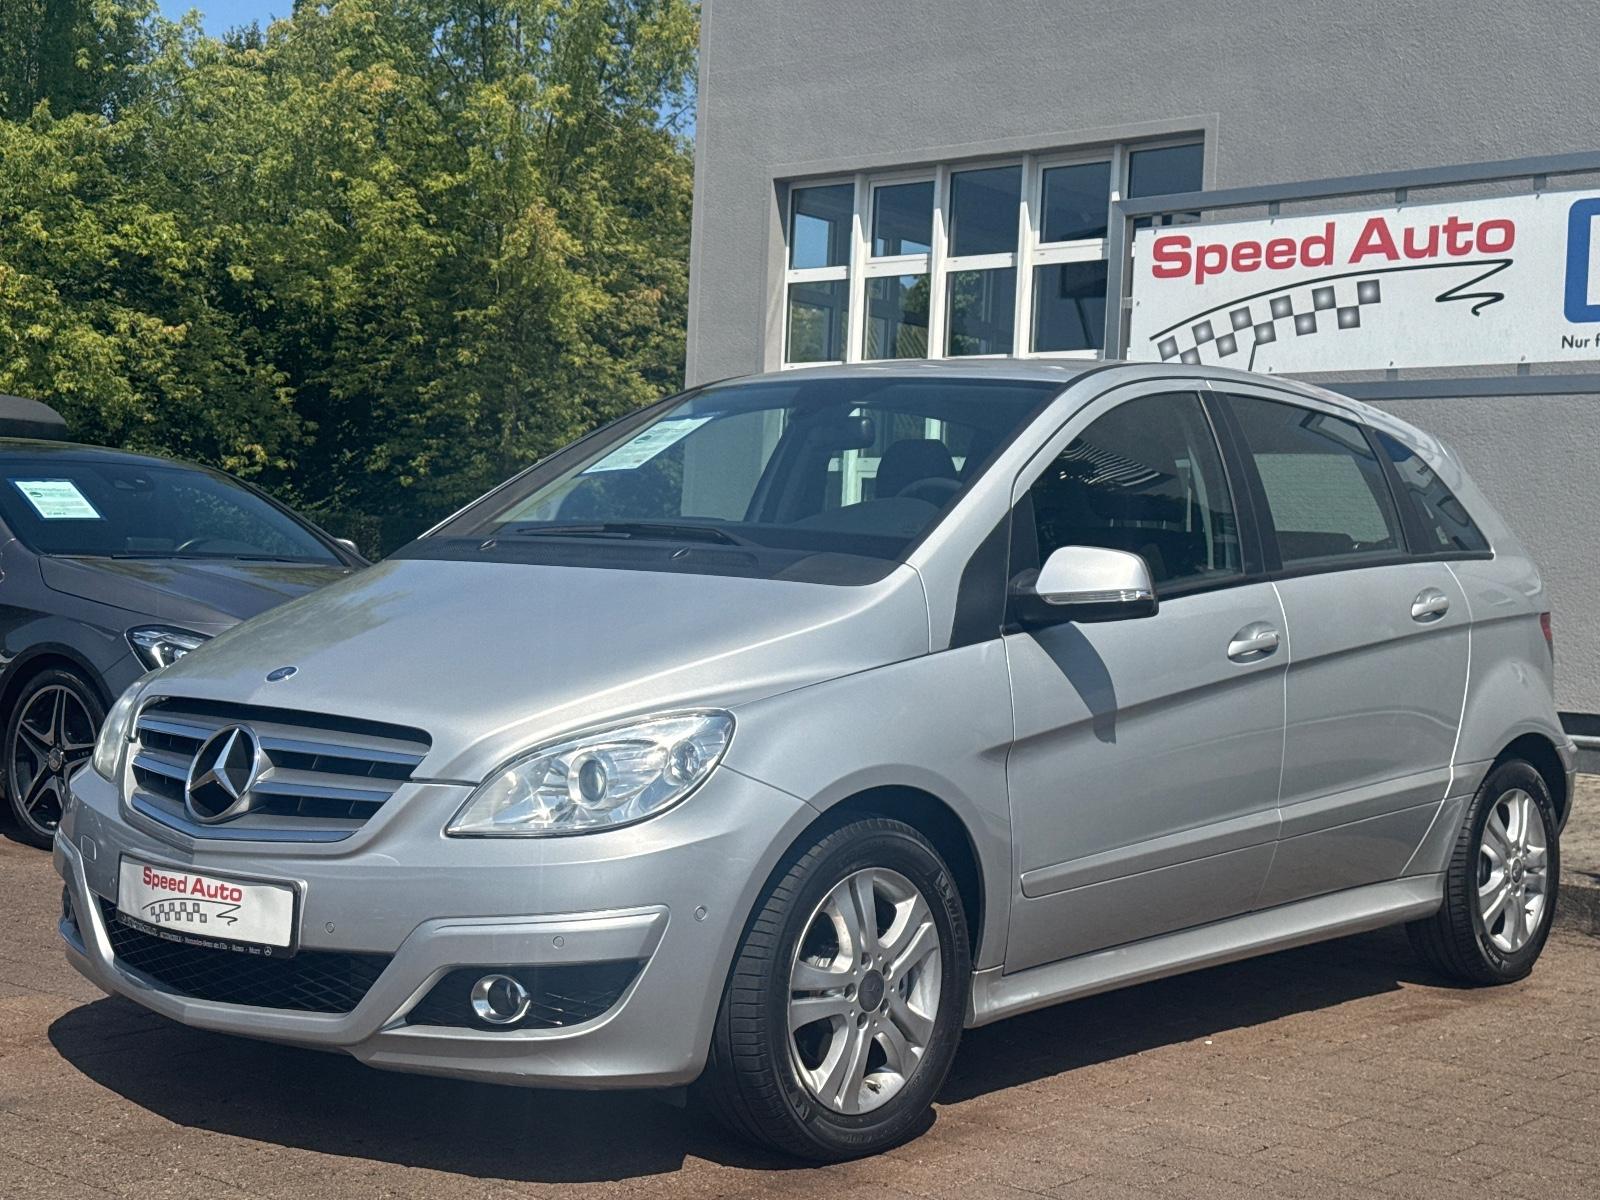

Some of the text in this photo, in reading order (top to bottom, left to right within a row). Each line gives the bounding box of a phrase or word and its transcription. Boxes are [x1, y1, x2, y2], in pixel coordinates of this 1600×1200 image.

[1152, 216, 1515, 285] Speed Auto
[1561, 335, 1591, 349] Nur
[142, 866, 243, 903] Speed Auto
